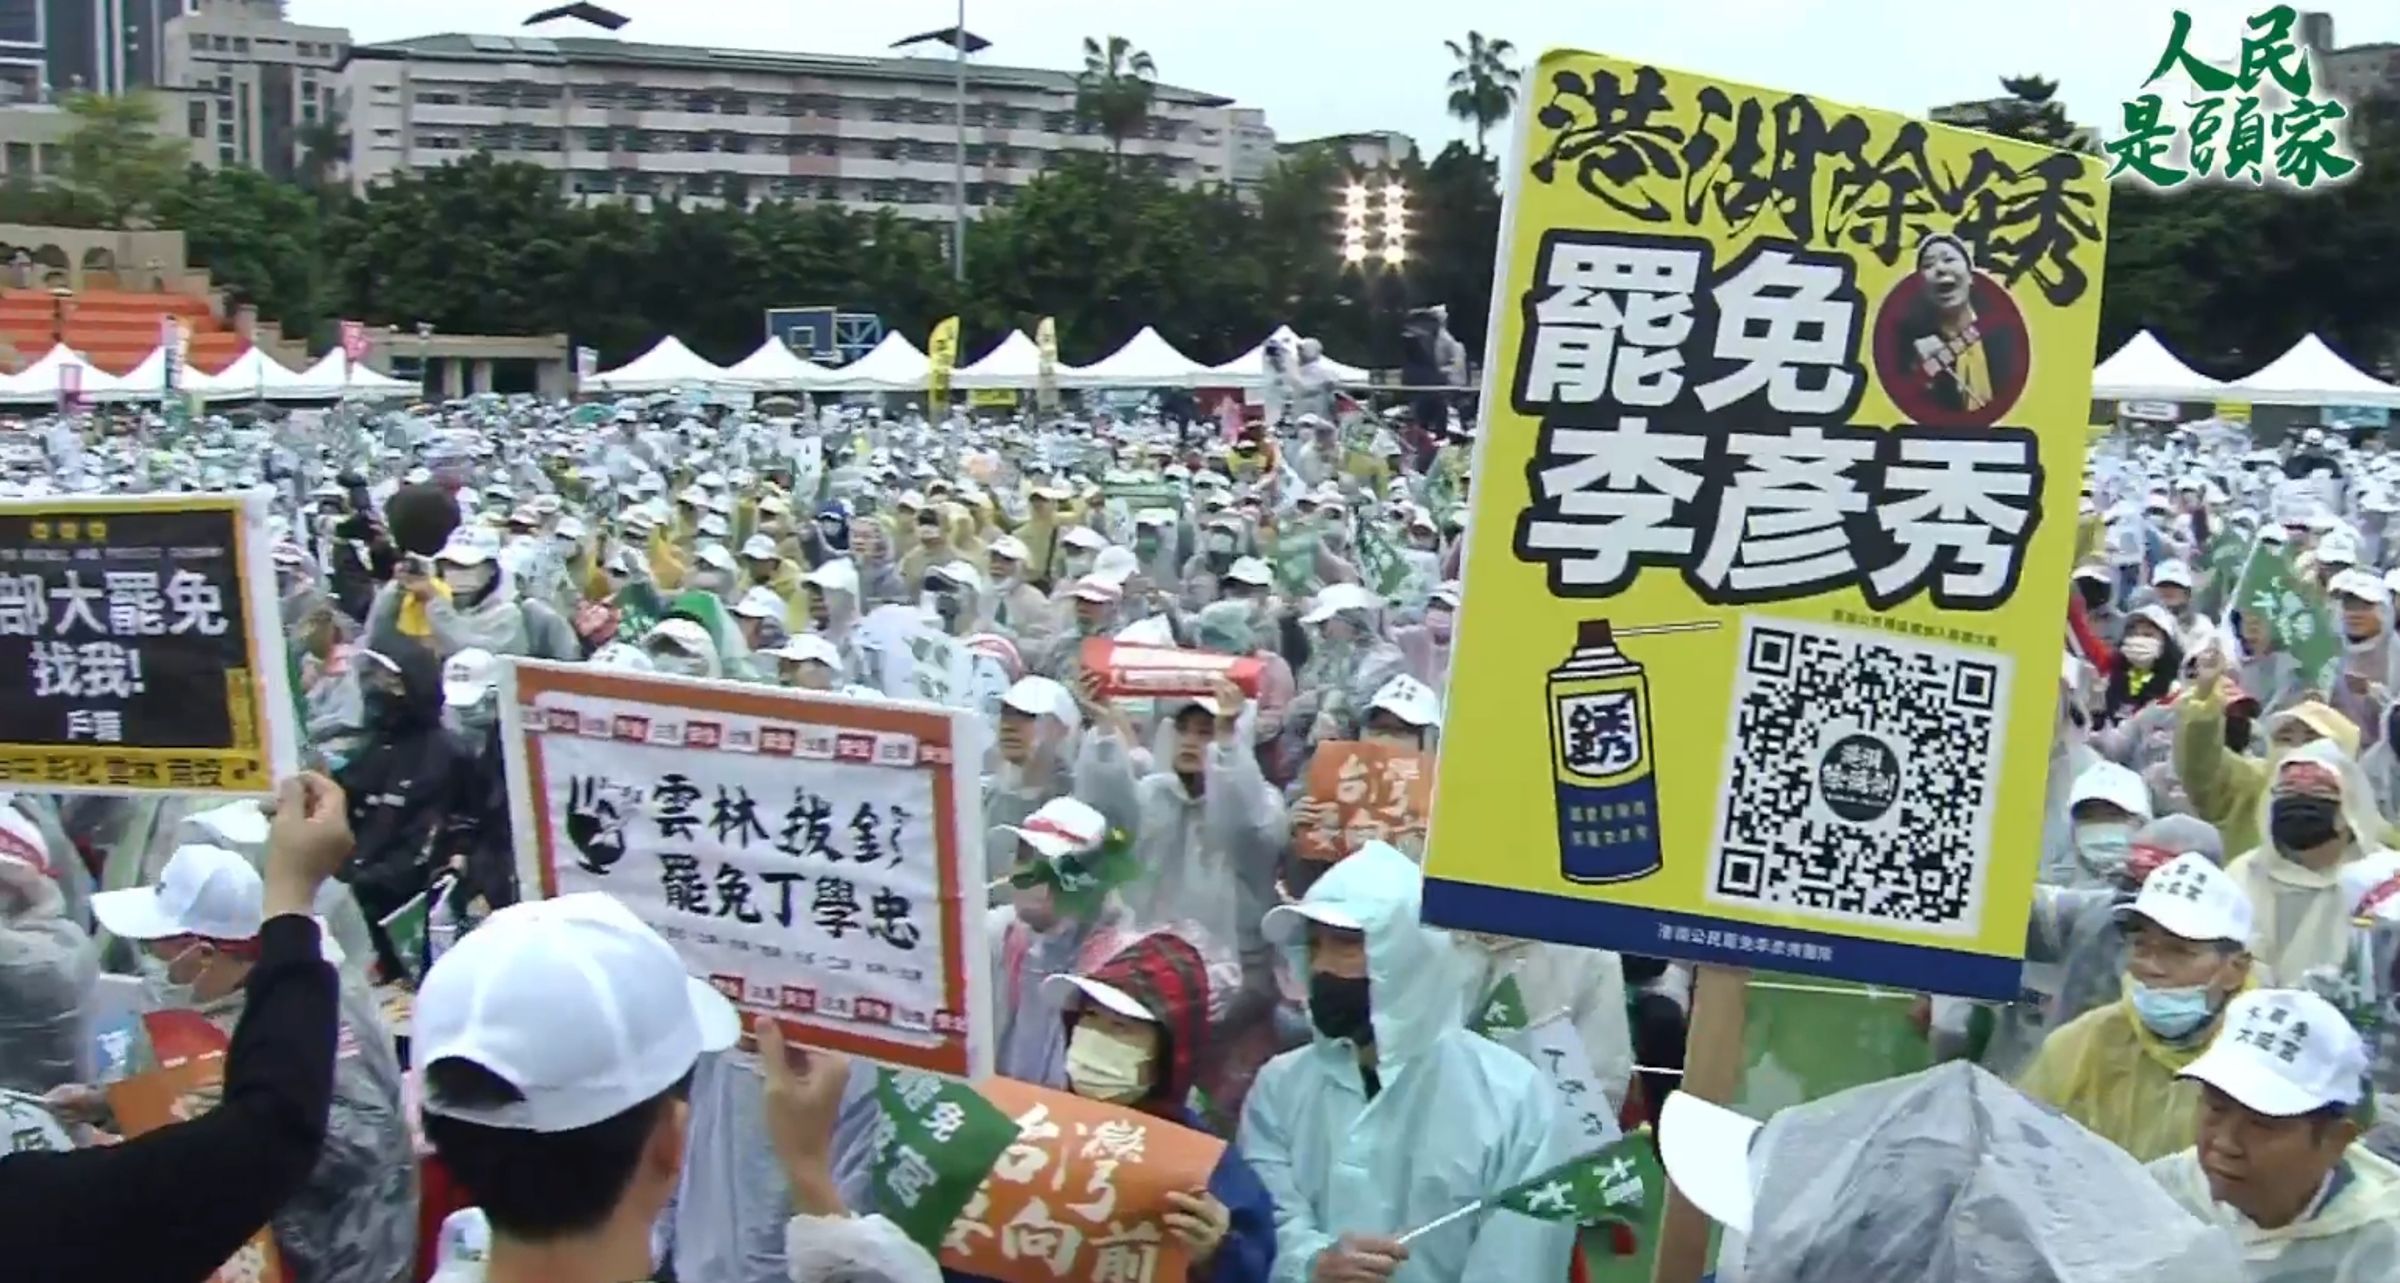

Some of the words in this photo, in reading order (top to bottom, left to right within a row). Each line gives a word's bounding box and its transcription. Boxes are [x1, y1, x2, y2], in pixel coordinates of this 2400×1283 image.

[1524, 242, 1855, 414] 罷免
[1525, 417, 2032, 598] 李彥秀
[29, 641, 145, 698] 找我!
[659, 853, 921, 950] 罷免丁學忠
[997, 1102, 1147, 1223] 台灣
